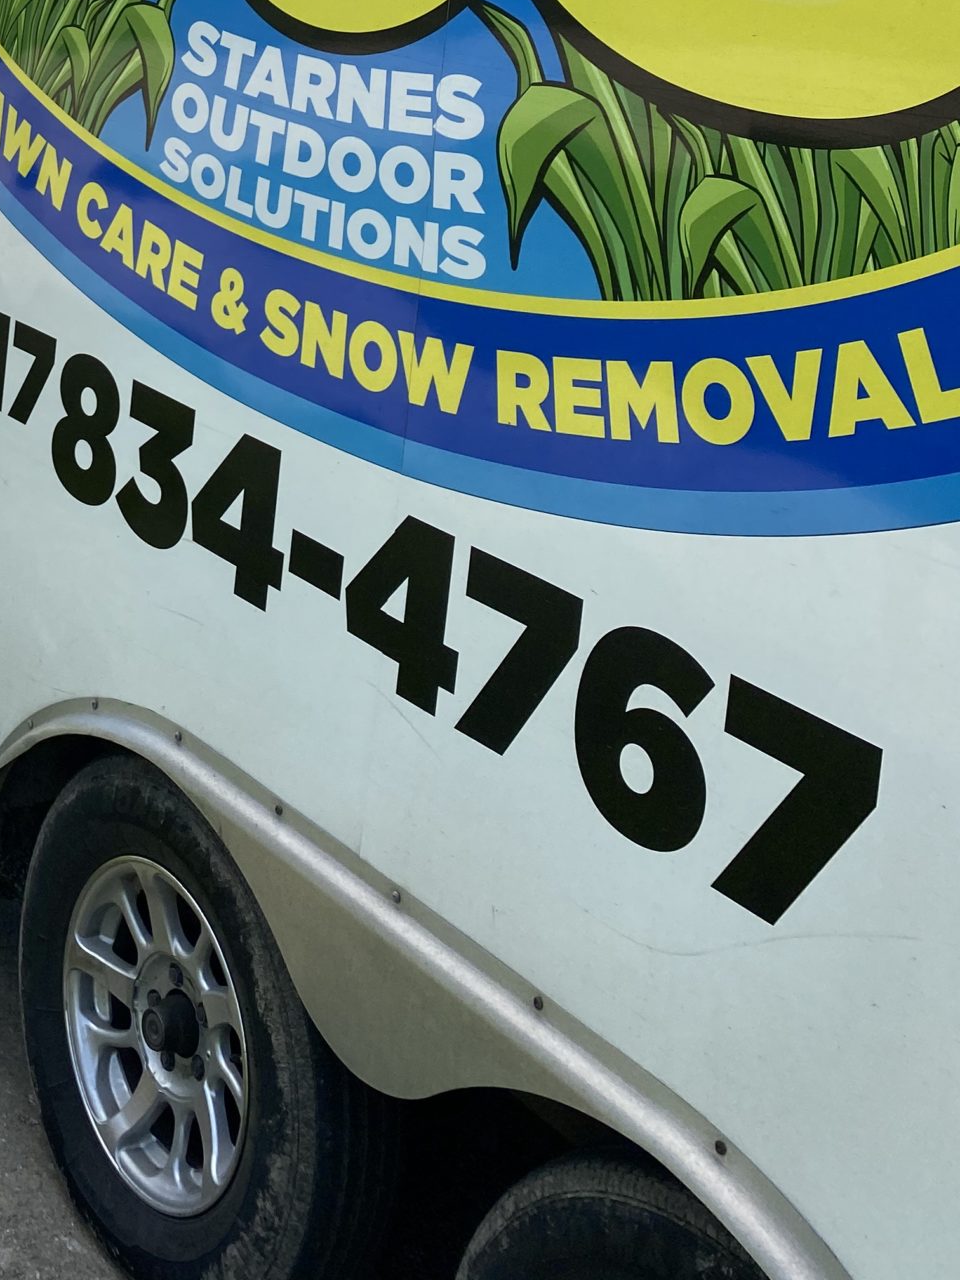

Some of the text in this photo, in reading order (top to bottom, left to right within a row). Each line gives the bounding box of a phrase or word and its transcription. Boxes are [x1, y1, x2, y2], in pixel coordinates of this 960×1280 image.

[181, 20, 484, 138] STARNES
[159, 137, 486, 281] SOLUTIONS
[171, 82, 484, 215] OUTDOOR
[76, 182, 204, 311] CARE
[210, 268, 249, 335] &
[260, 288, 475, 415] SNOW
[496, 327, 960, 446] REMOVAL
